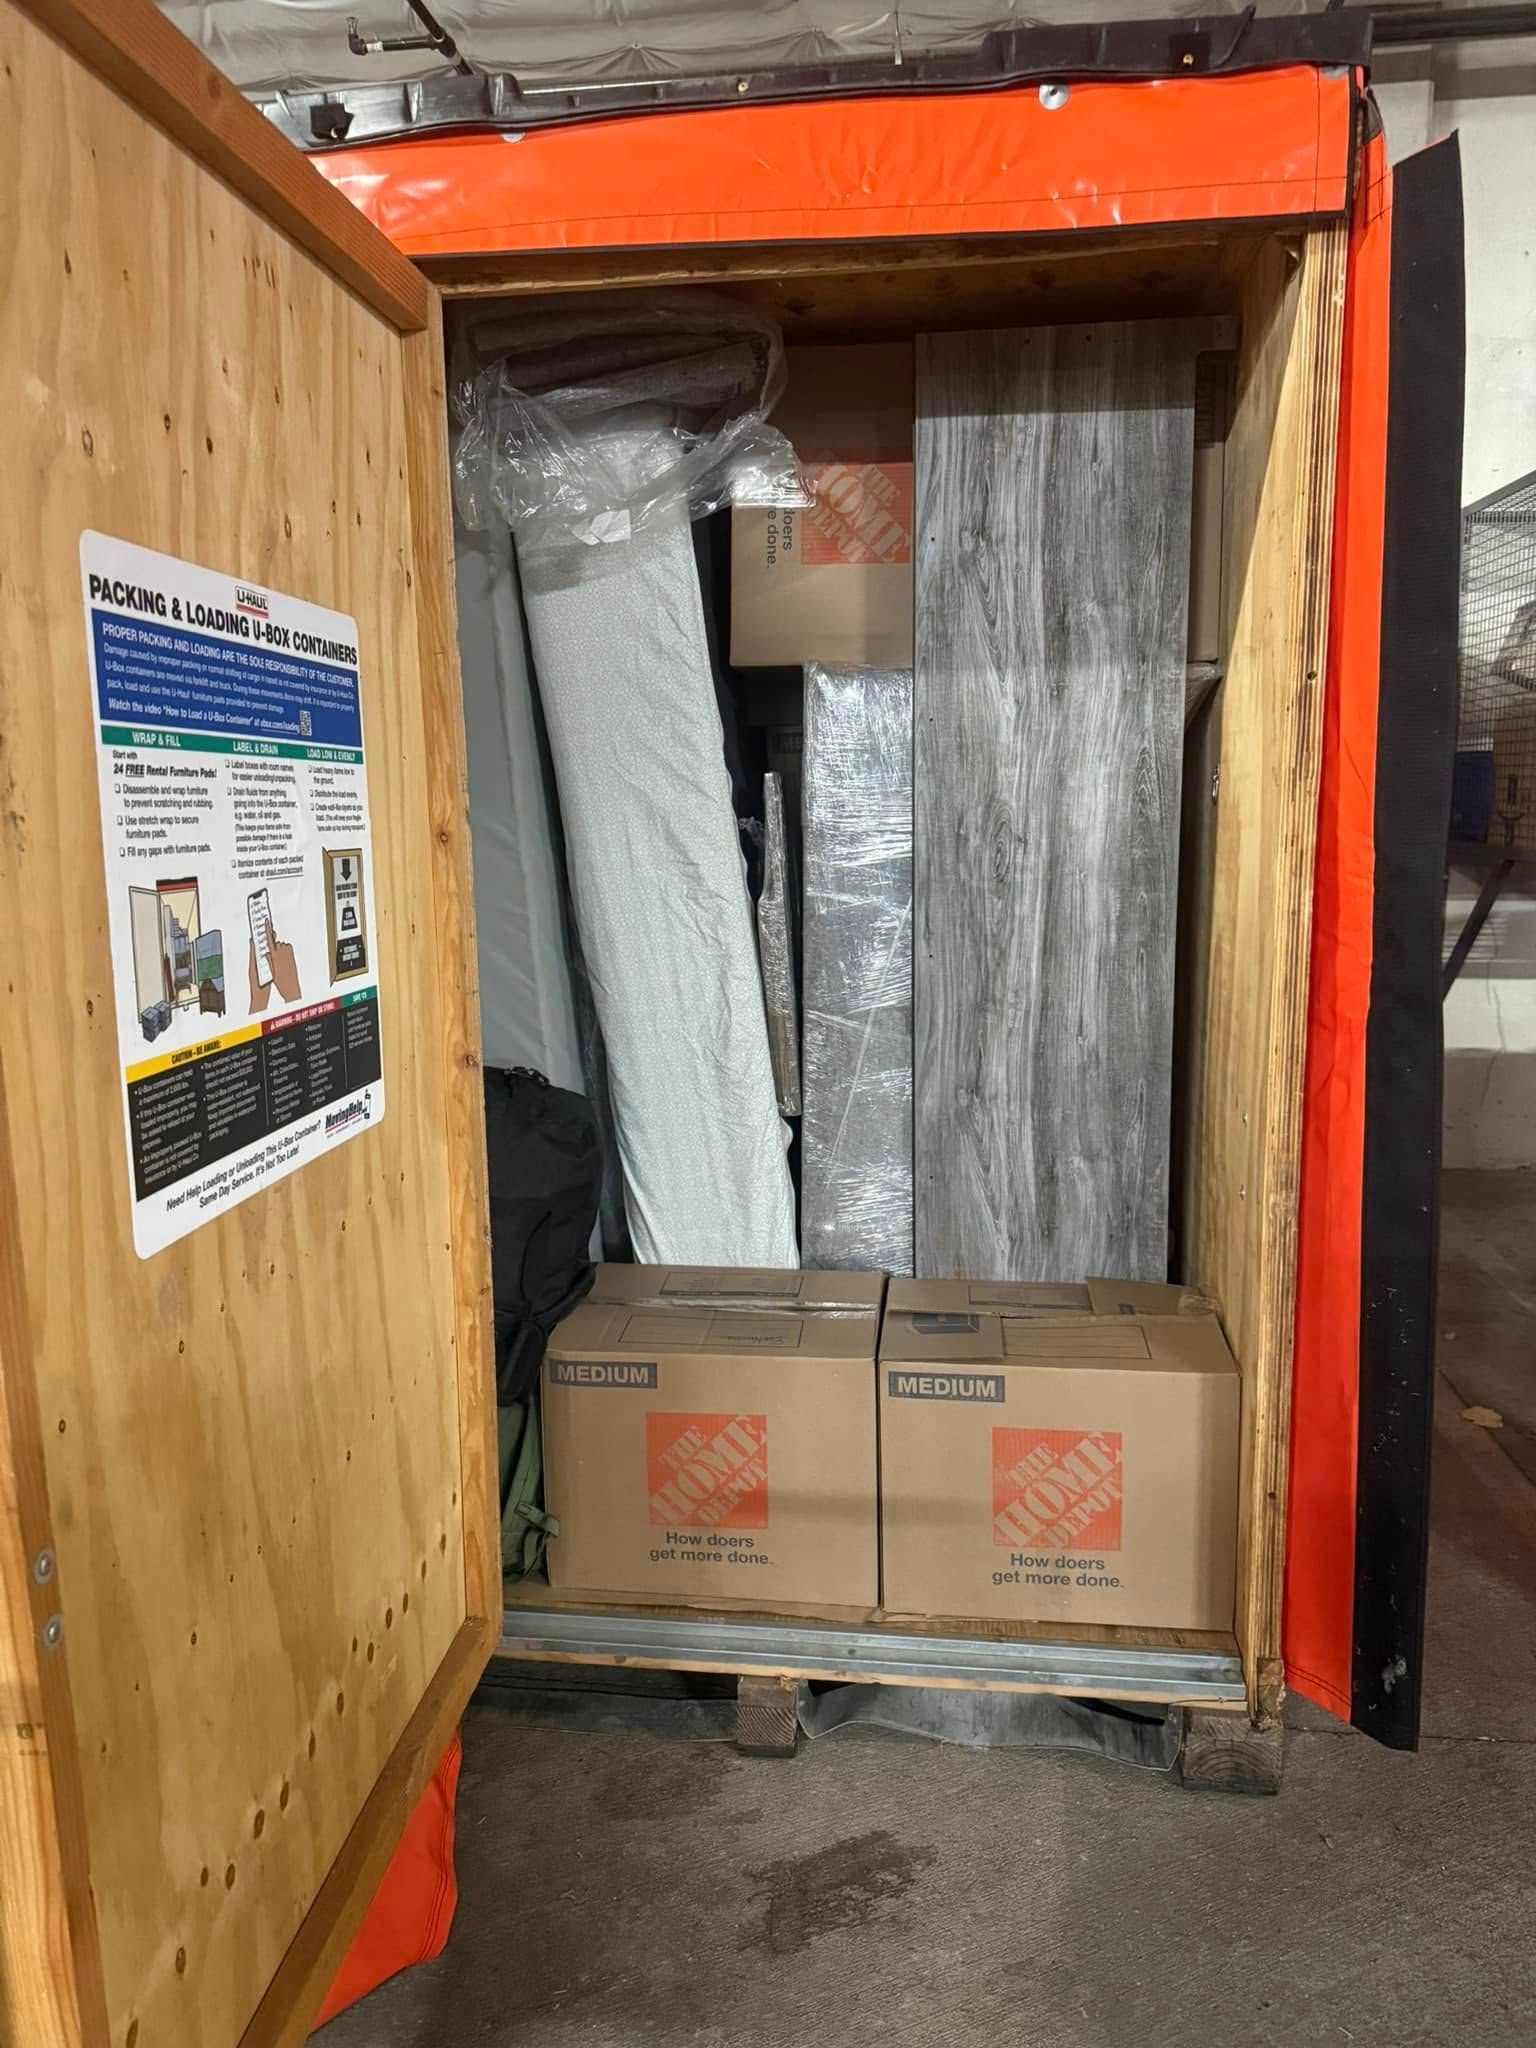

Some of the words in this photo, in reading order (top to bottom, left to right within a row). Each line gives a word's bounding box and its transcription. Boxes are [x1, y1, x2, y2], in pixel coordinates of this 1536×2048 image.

[859, 464, 899, 505] THE
[767, 524, 778, 568] done.
[237, 589, 268, 610] U-HAUL
[88, 573, 166, 617] PACKING
[170, 596, 182, 621] &
[186, 600, 249, 638] LOADING
[252, 619, 290, 648] U-BOX
[292, 630, 357, 664] CONTAINERS
[102, 622, 137, 641] PROPER
[139, 630, 172, 649] PACKING
[173, 638, 189, 652] AND
[190, 642, 220, 659] LOADING
[221, 649, 235, 662] ARE
[235, 652, 248, 665] THE
[248, 655, 264, 668] SOLE
[265, 658, 307, 677] RESPONSIBILITY
[308, 668, 315, 679] OF
[316, 670, 326, 681] THE
[105, 659, 124, 672] U-Box
[108, 697, 130, 711] Watch
[131, 700, 143, 712] the
[144, 702, 161, 714] video
[180, 707, 187, 718] to
[187, 708, 202, 719] Load
[203, 710, 207, 720] a
[208, 711, 224, 722] U-Box
[131, 731, 156, 744] WRAP
[157, 733, 164, 745] &
[165, 734, 181, 746] FILL
[232, 740, 253, 752] LABEL
[260, 743, 278, 754] DRAIN
[112, 749, 125, 758] Start
[126, 750, 137, 759] with
[112, 763, 123, 774] 24
[124, 763, 144, 775] FREE
[145, 764, 168, 776] Rental
[169, 766, 198, 777] Furniture
[199, 767, 216, 777] Pads!
[122, 784, 159, 794] Disassemble
[160, 785, 171, 794] and
[172, 785, 185, 796] wrap
[186, 785, 208, 794] furniture
[124, 798, 129, 807] to
[131, 798, 152, 809] prevent
[153, 798, 181, 809] scratching
[182, 798, 192, 807] and
[193, 799, 213, 809] rubbing.
[125, 816, 137, 825] Use
[138, 815, 158, 825] stretch
[159, 815, 173, 825] wrap
[174, 815, 180, 824] to
[181, 815, 198, 823] secure
[126, 829, 150, 838] furniture
[151, 828, 167, 839] pads.
[127, 846, 135, 856] Fill
[136, 846, 147, 857] any
[148, 845, 162, 857] gaps
[163, 844, 174, 853] with
[175, 843, 196, 853] furniture
[197, 842, 211, 853] pads.
[325, 1097, 362, 1132] MovingHelp
[166, 1191, 185, 1211] Need
[186, 1183, 201, 1202] Help
[202, 1169, 227, 1193] Loading
[228, 1165, 234, 1177] or
[236, 1149, 264, 1175] Unloading
[265, 1143, 276, 1157] This
[277, 1134, 293, 1151] U-Box
[294, 1119, 321, 1142] Container?
[199, 1188, 217, 1208] Same
[218, 1180, 231, 1199] Day
[231, 1168, 254, 1190] Service.
[255, 1162, 264, 1177] It's
[265, 1156, 275, 1171] Not
[276, 1151, 285, 1165] Too
[286, 1143, 299, 1159] Late!
[557, 1364, 649, 1384] MEDIUM
[896, 1376, 996, 1397] MEDIUM
[660, 1426, 706, 1471] THE
[651, 1415, 768, 1525] HOME
[1006, 1442, 1059, 1488] THE
[697, 1457, 768, 1524] DEPOT
[994, 1431, 1121, 1546] HOME
[1043, 1473, 1122, 1548] DEPOT
[666, 1531, 702, 1546] How
[707, 1533, 754, 1547] doers
[649, 1549, 675, 1562] get
[681, 1551, 722, 1562] more
[728, 1551, 775, 1564] done.
[1010, 1553, 1049, 1568] How
[1055, 1555, 1105, 1569] doers
[992, 1572, 1020, 1585] get
[1025, 1573, 1070, 1585] more
[1076, 1573, 1125, 1588] done.
